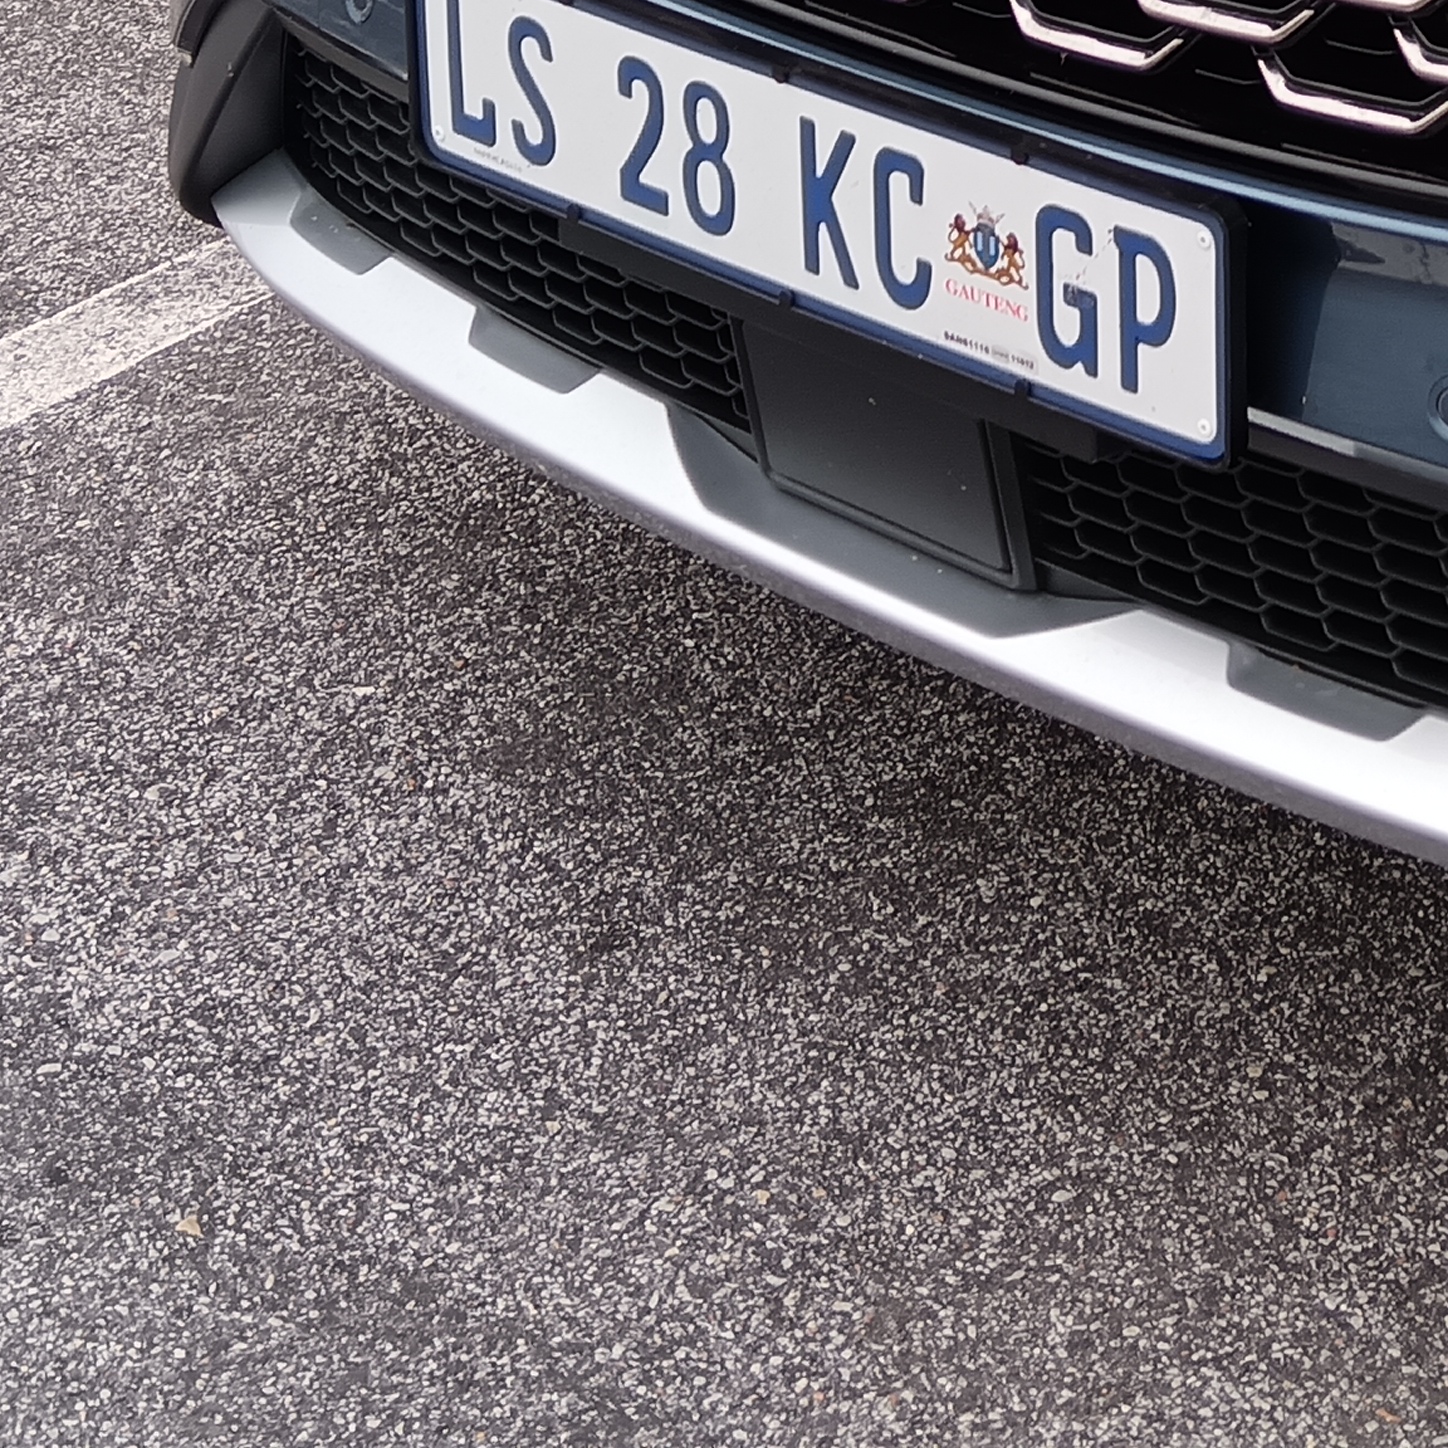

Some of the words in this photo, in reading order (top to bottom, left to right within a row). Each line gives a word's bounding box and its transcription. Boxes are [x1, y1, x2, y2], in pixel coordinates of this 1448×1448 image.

[616, 55, 737, 237] 28
[799, 115, 933, 311] KC
[1034, 203, 1177, 394] GP
[944, 277, 1029, 323] GAUTENG
